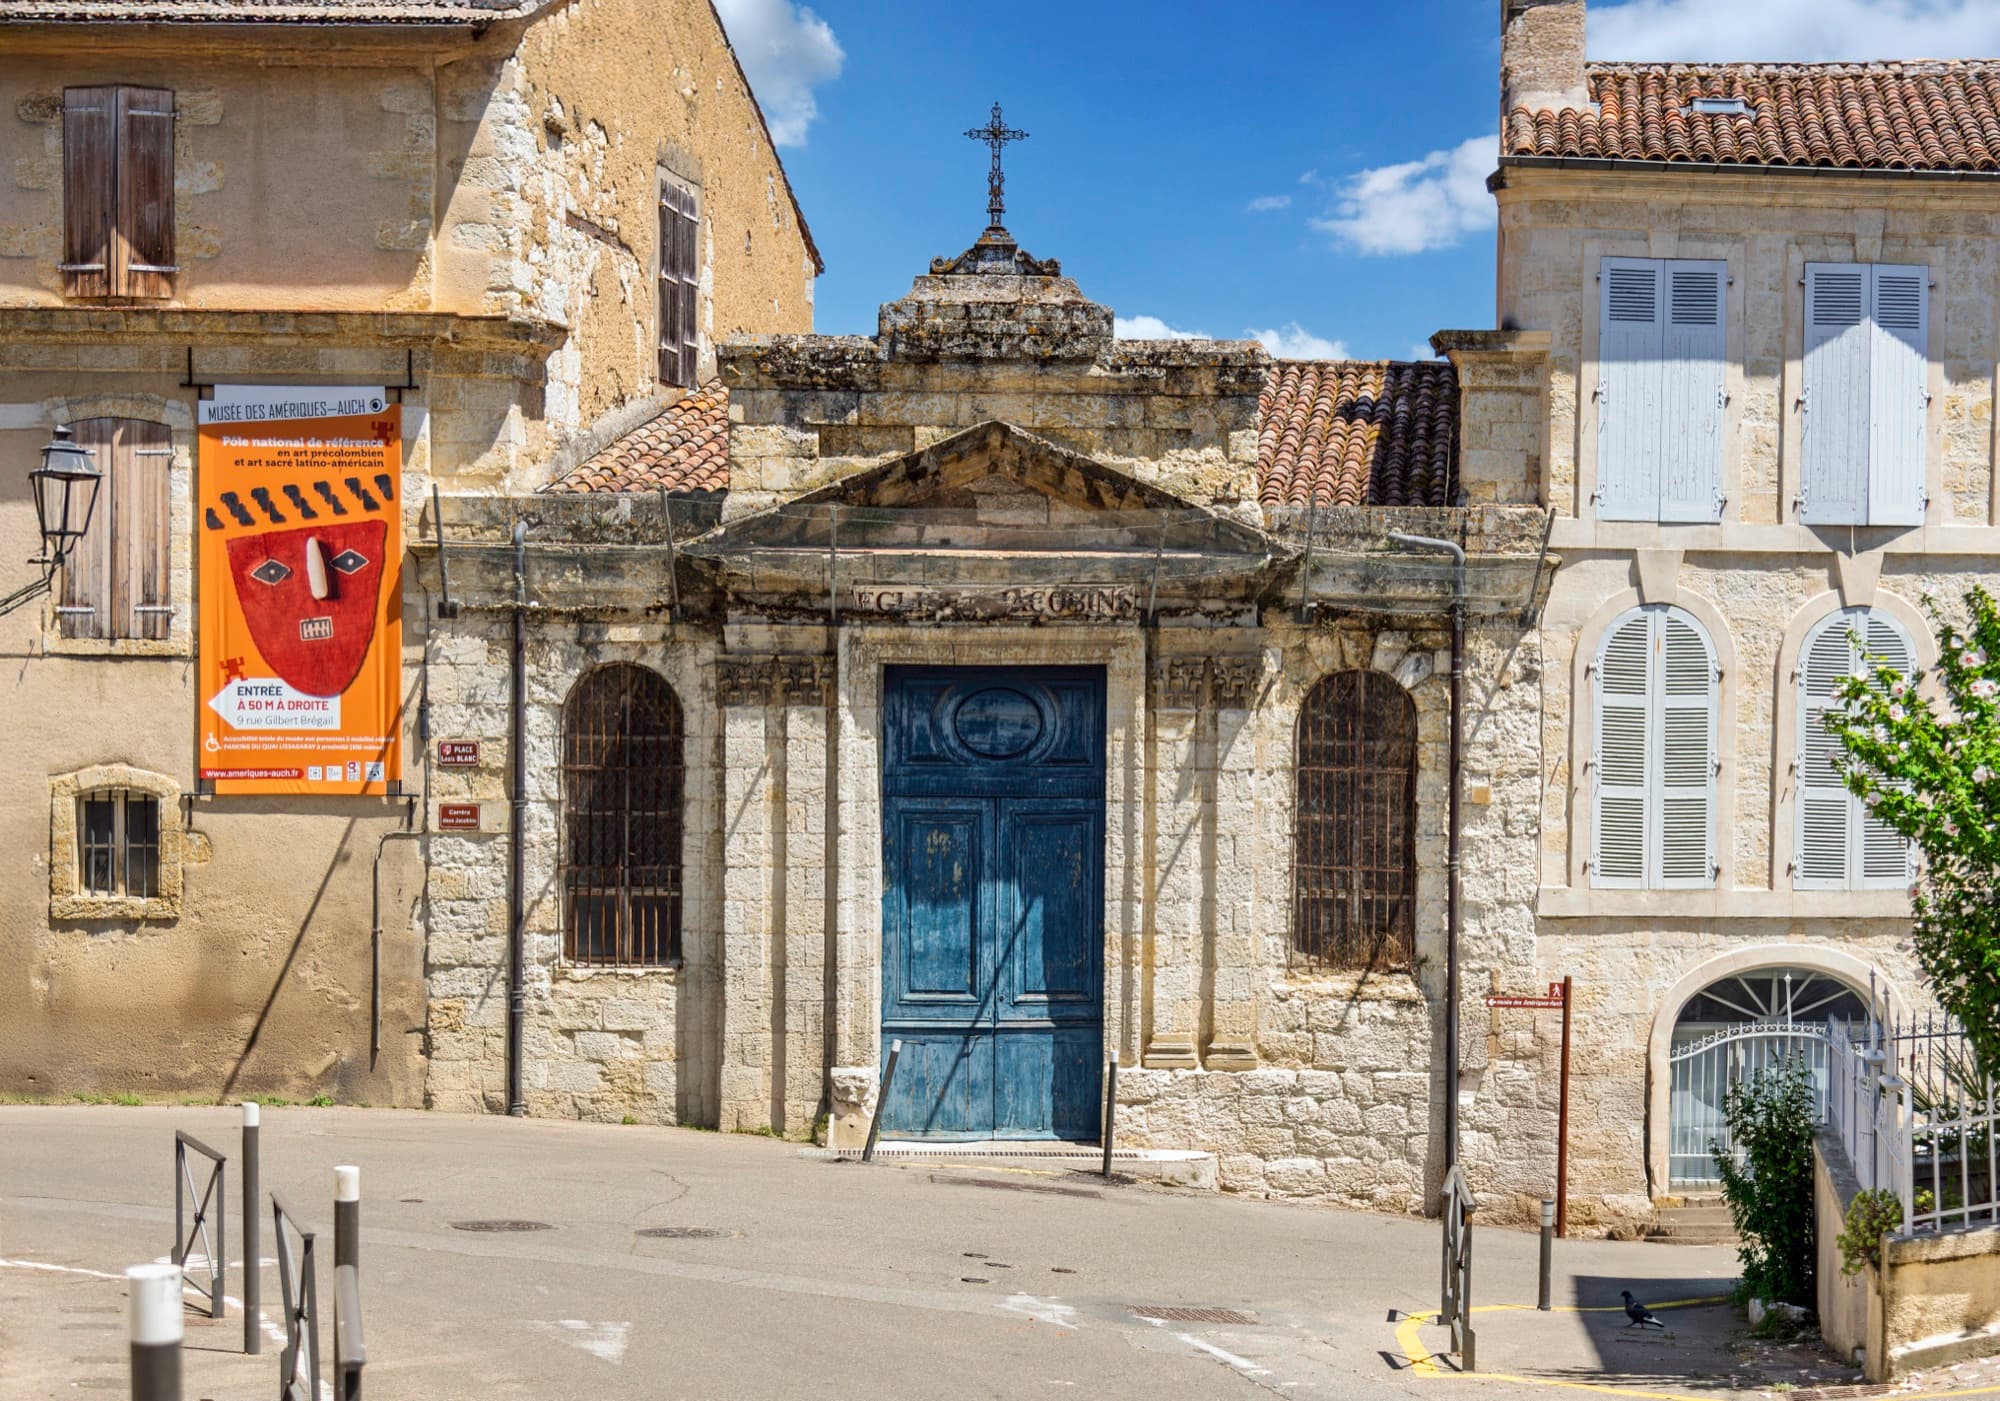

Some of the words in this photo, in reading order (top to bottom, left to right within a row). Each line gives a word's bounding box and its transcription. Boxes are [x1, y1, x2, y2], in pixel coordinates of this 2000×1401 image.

[208, 403, 242, 421] MUSÉE
[245, 404, 266, 420] DES
[222, 436, 249, 448] Pôle
[252, 436, 304, 448] national
[308, 436, 323, 448] de
[325, 436, 384, 448] référence
[293, 449, 308, 457] art
[311, 448, 384, 460] précolombien
[234, 459, 245, 467] et
[247, 458, 262, 467] art
[265, 458, 293, 467] sacré
[295, 458, 384, 468] latino-américain
[237, 685, 283, 697] ENTRÉE
[237, 699, 245, 711] À
[248, 700, 261, 711] 50
[265, 700, 274, 711] M
[277, 699, 286, 711] À
[287, 700, 329, 711] DROITE
[237, 716, 244, 725] 9
[265, 715, 298, 725] Gilbert
[300, 715, 334, 728] Brégail
[206, 769, 299, 779] www.ameriques-auch.fr
